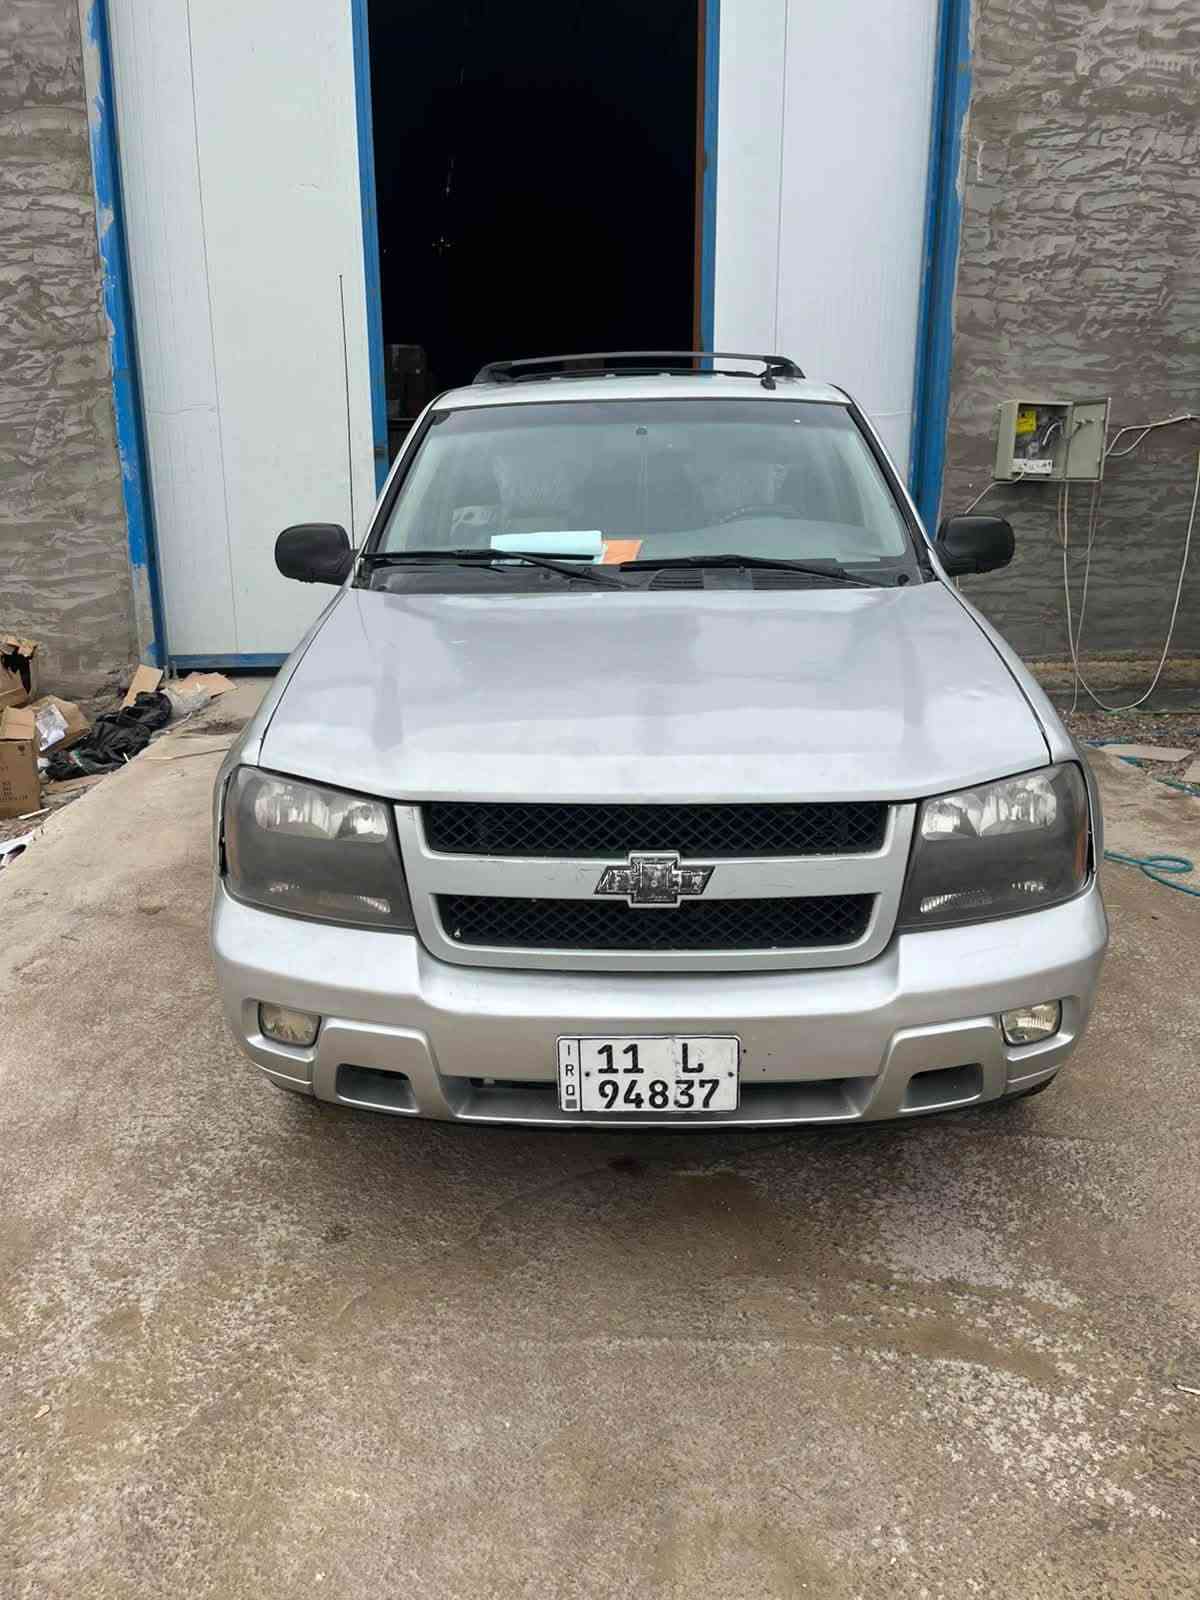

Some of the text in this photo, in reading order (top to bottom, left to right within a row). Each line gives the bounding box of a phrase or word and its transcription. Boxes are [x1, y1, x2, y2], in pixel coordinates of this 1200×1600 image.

[597, 1043, 704, 1074] 11 L
[598, 1079, 720, 1109] 94837
